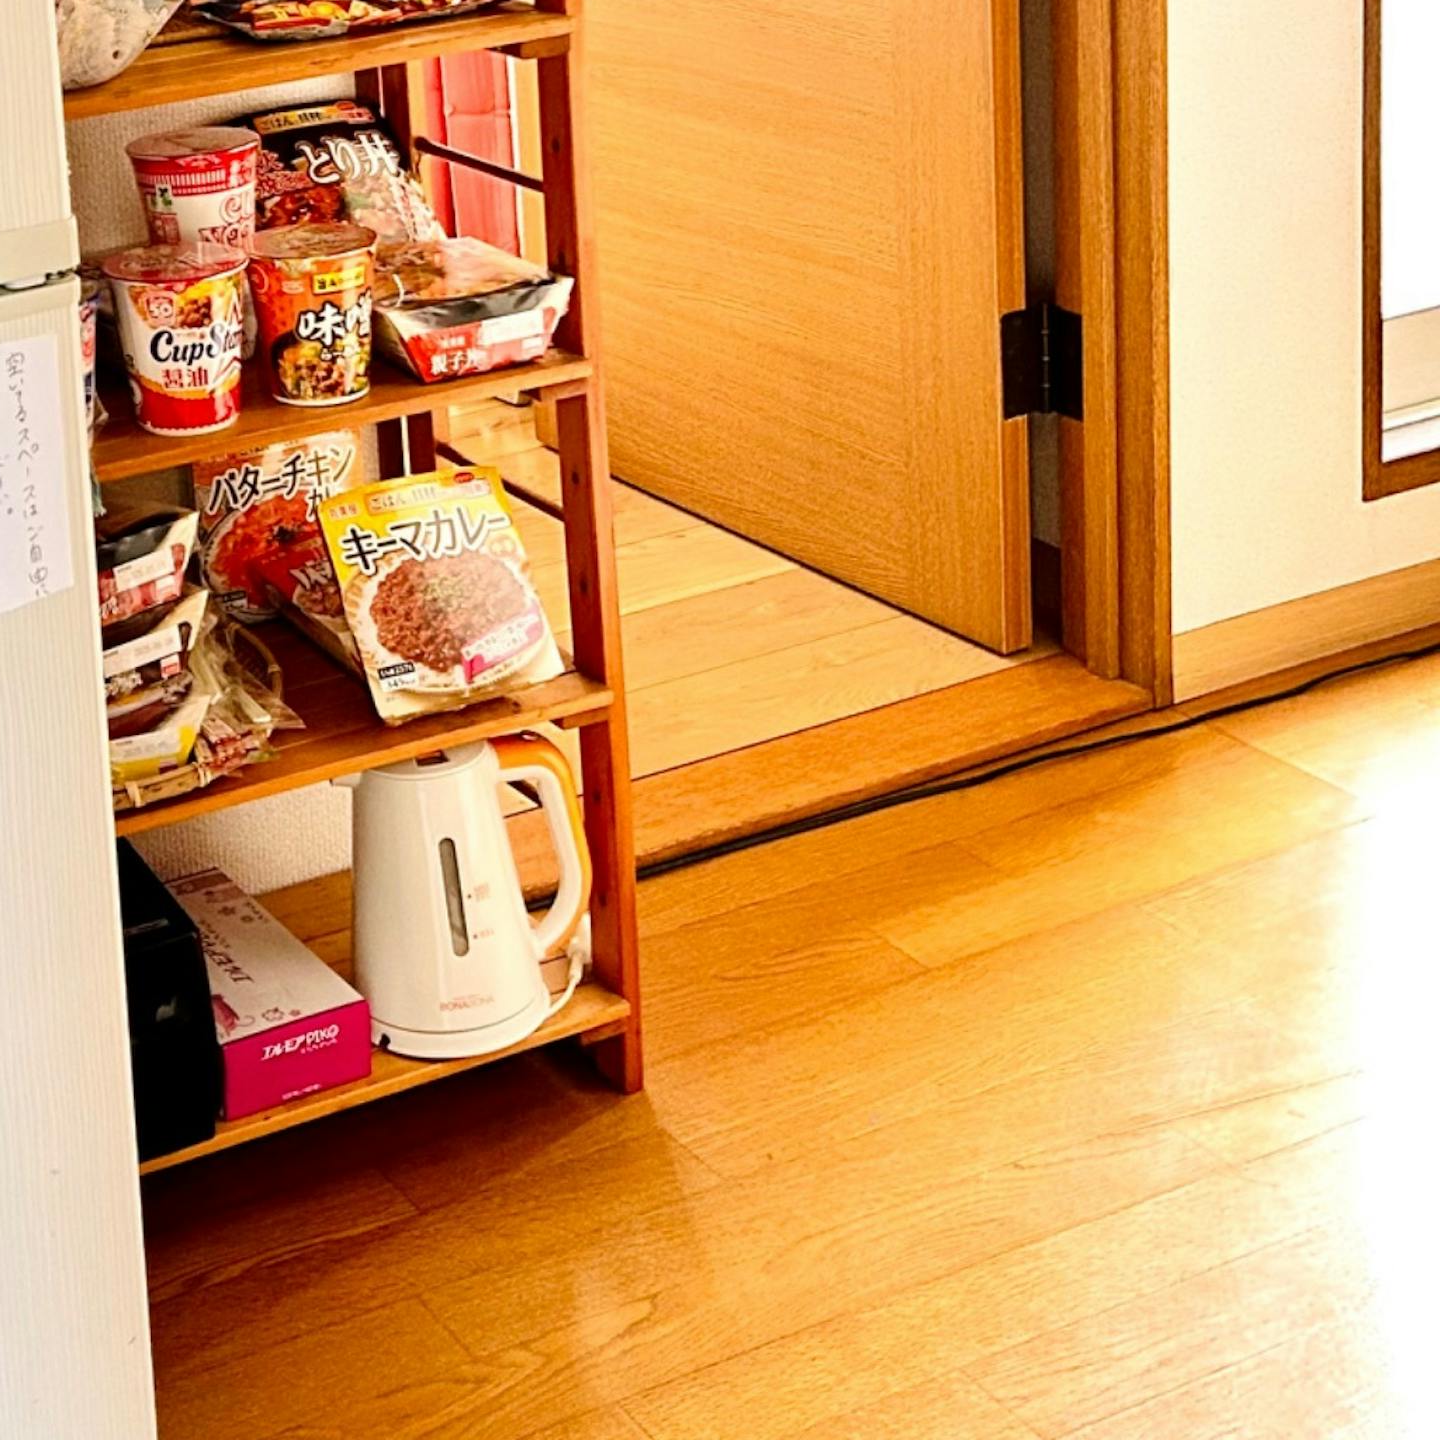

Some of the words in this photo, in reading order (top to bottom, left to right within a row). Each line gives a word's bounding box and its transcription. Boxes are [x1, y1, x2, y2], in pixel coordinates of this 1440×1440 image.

[293, 128, 401, 186] とり丼
[162, 365, 210, 389] 醤油
[209, 449, 354, 514] バターチキン
[342, 507, 506, 571] キーマカレー
